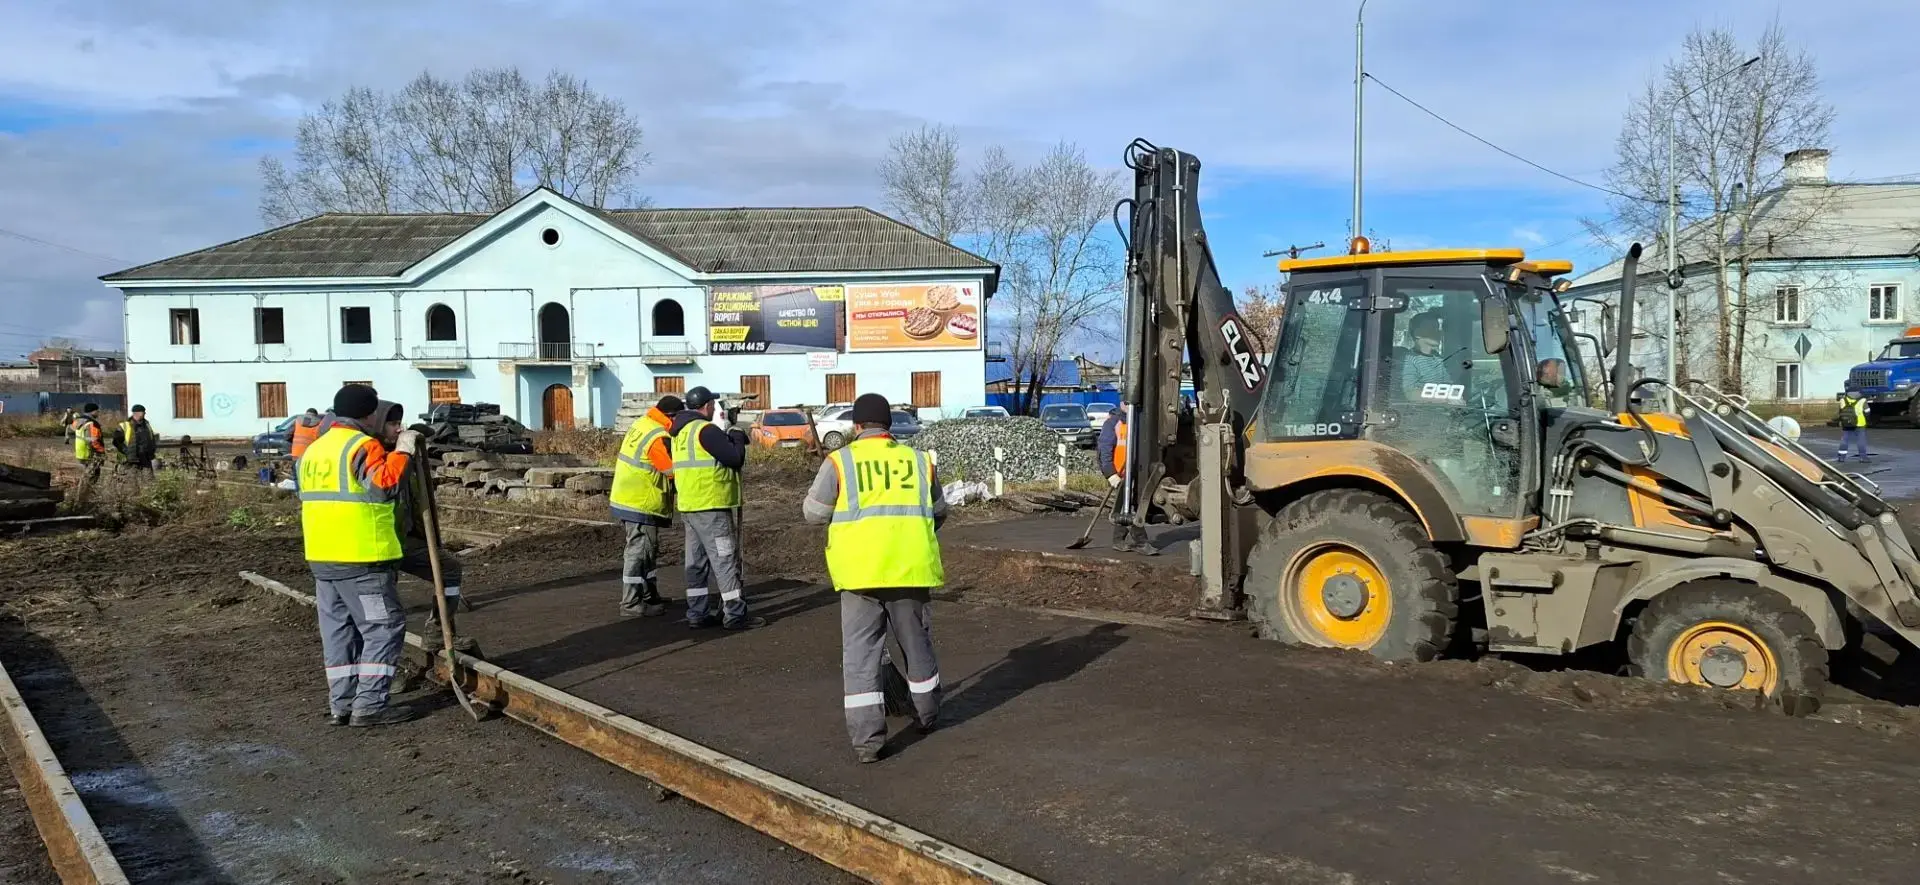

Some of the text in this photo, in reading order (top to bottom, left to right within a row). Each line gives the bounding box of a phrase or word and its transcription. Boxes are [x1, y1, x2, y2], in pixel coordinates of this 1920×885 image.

[713, 292, 753, 301] ГАРАЖНЫЕ
[1308, 287, 1342, 305] 4x4
[713, 302, 761, 311] СЕКЦИОННЫЕ
[713, 312, 741, 322] ВОРОТА
[867, 310, 905, 318] ОТКРЫЛИСЬ
[712, 342, 765, 352] 8 902 764 44 25
[1220, 319, 1261, 389] ELAZ
[1421, 383, 1465, 400] 880
[1285, 423, 1341, 436] TURBO
[856, 459, 914, 492] ПЧ-2
